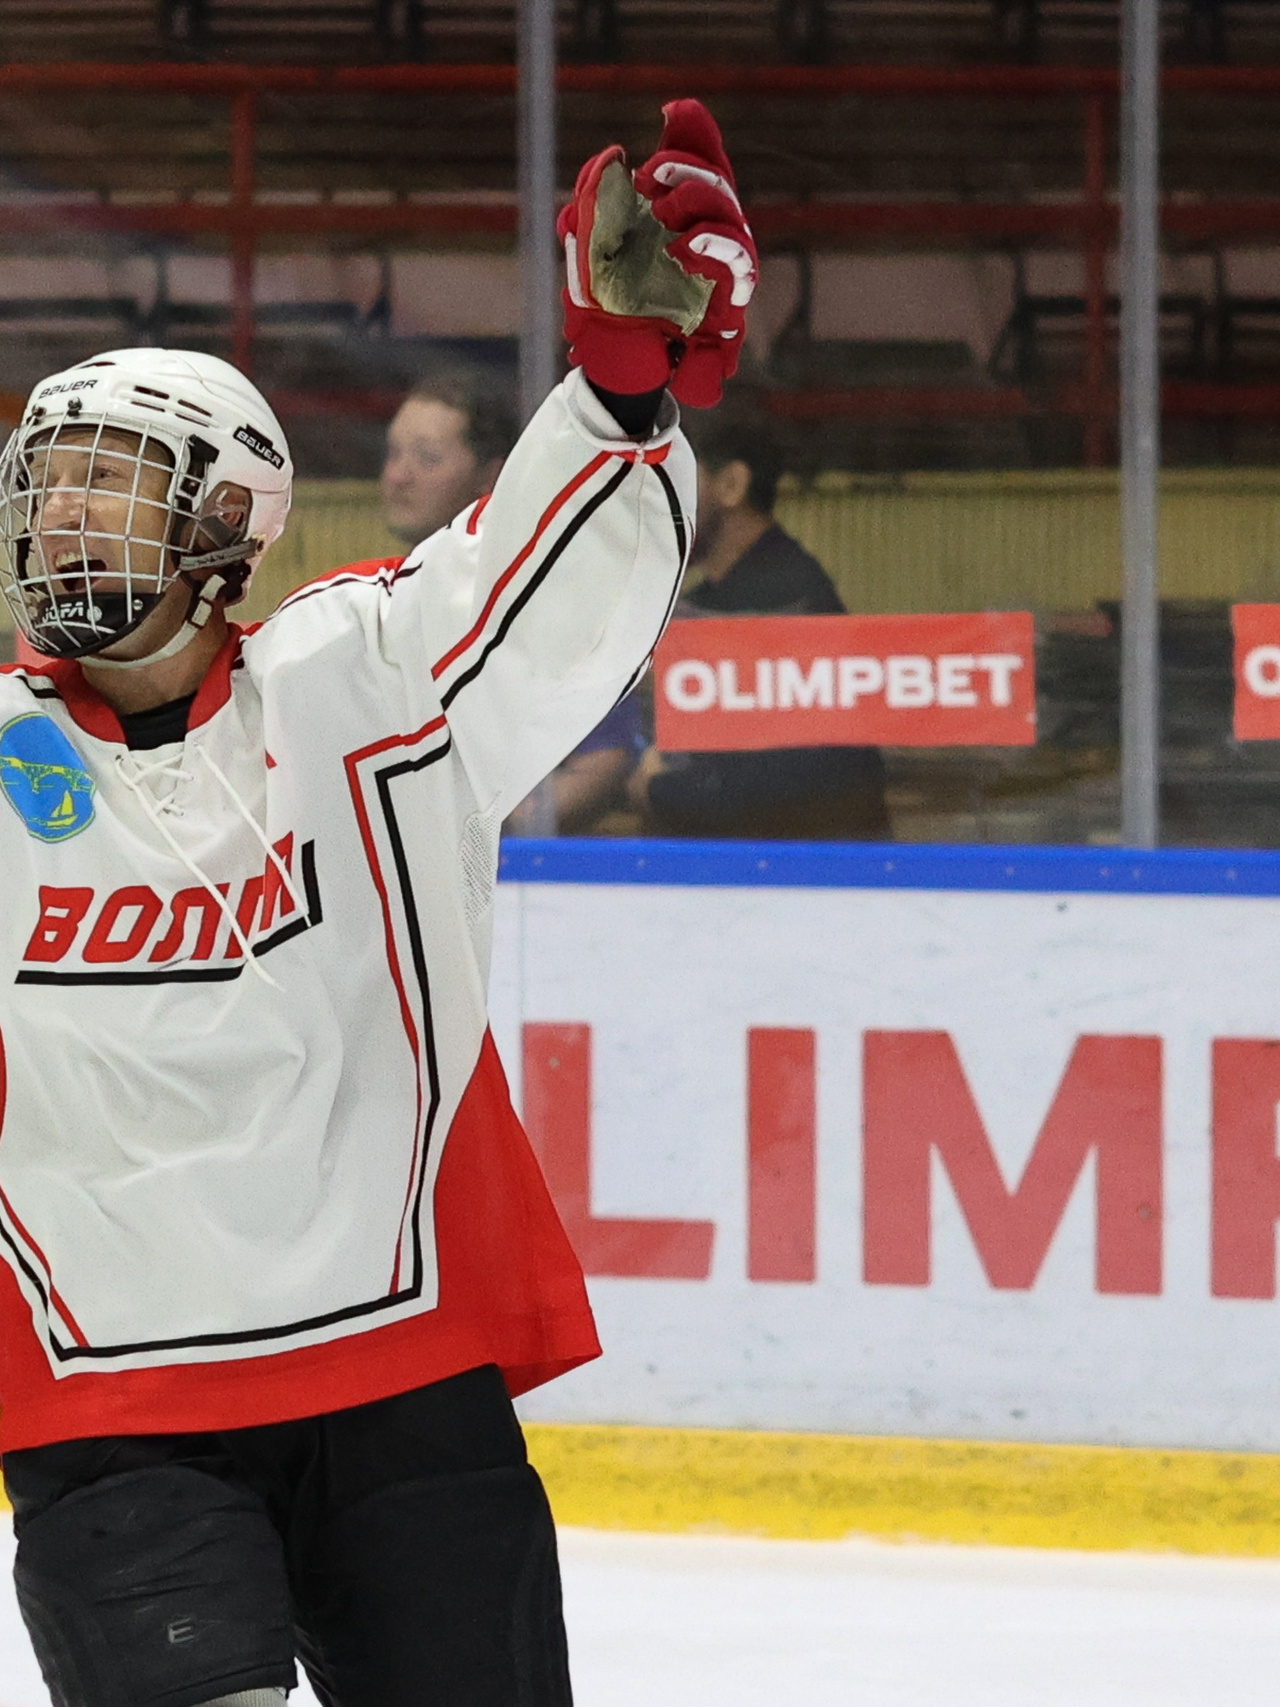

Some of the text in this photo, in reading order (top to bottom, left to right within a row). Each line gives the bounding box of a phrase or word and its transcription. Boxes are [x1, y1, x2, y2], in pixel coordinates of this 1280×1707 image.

[38, 379, 98, 399] BAUER
[236, 430, 281, 467] BAUER
[663, 654, 1022, 713] OLIMPBET
